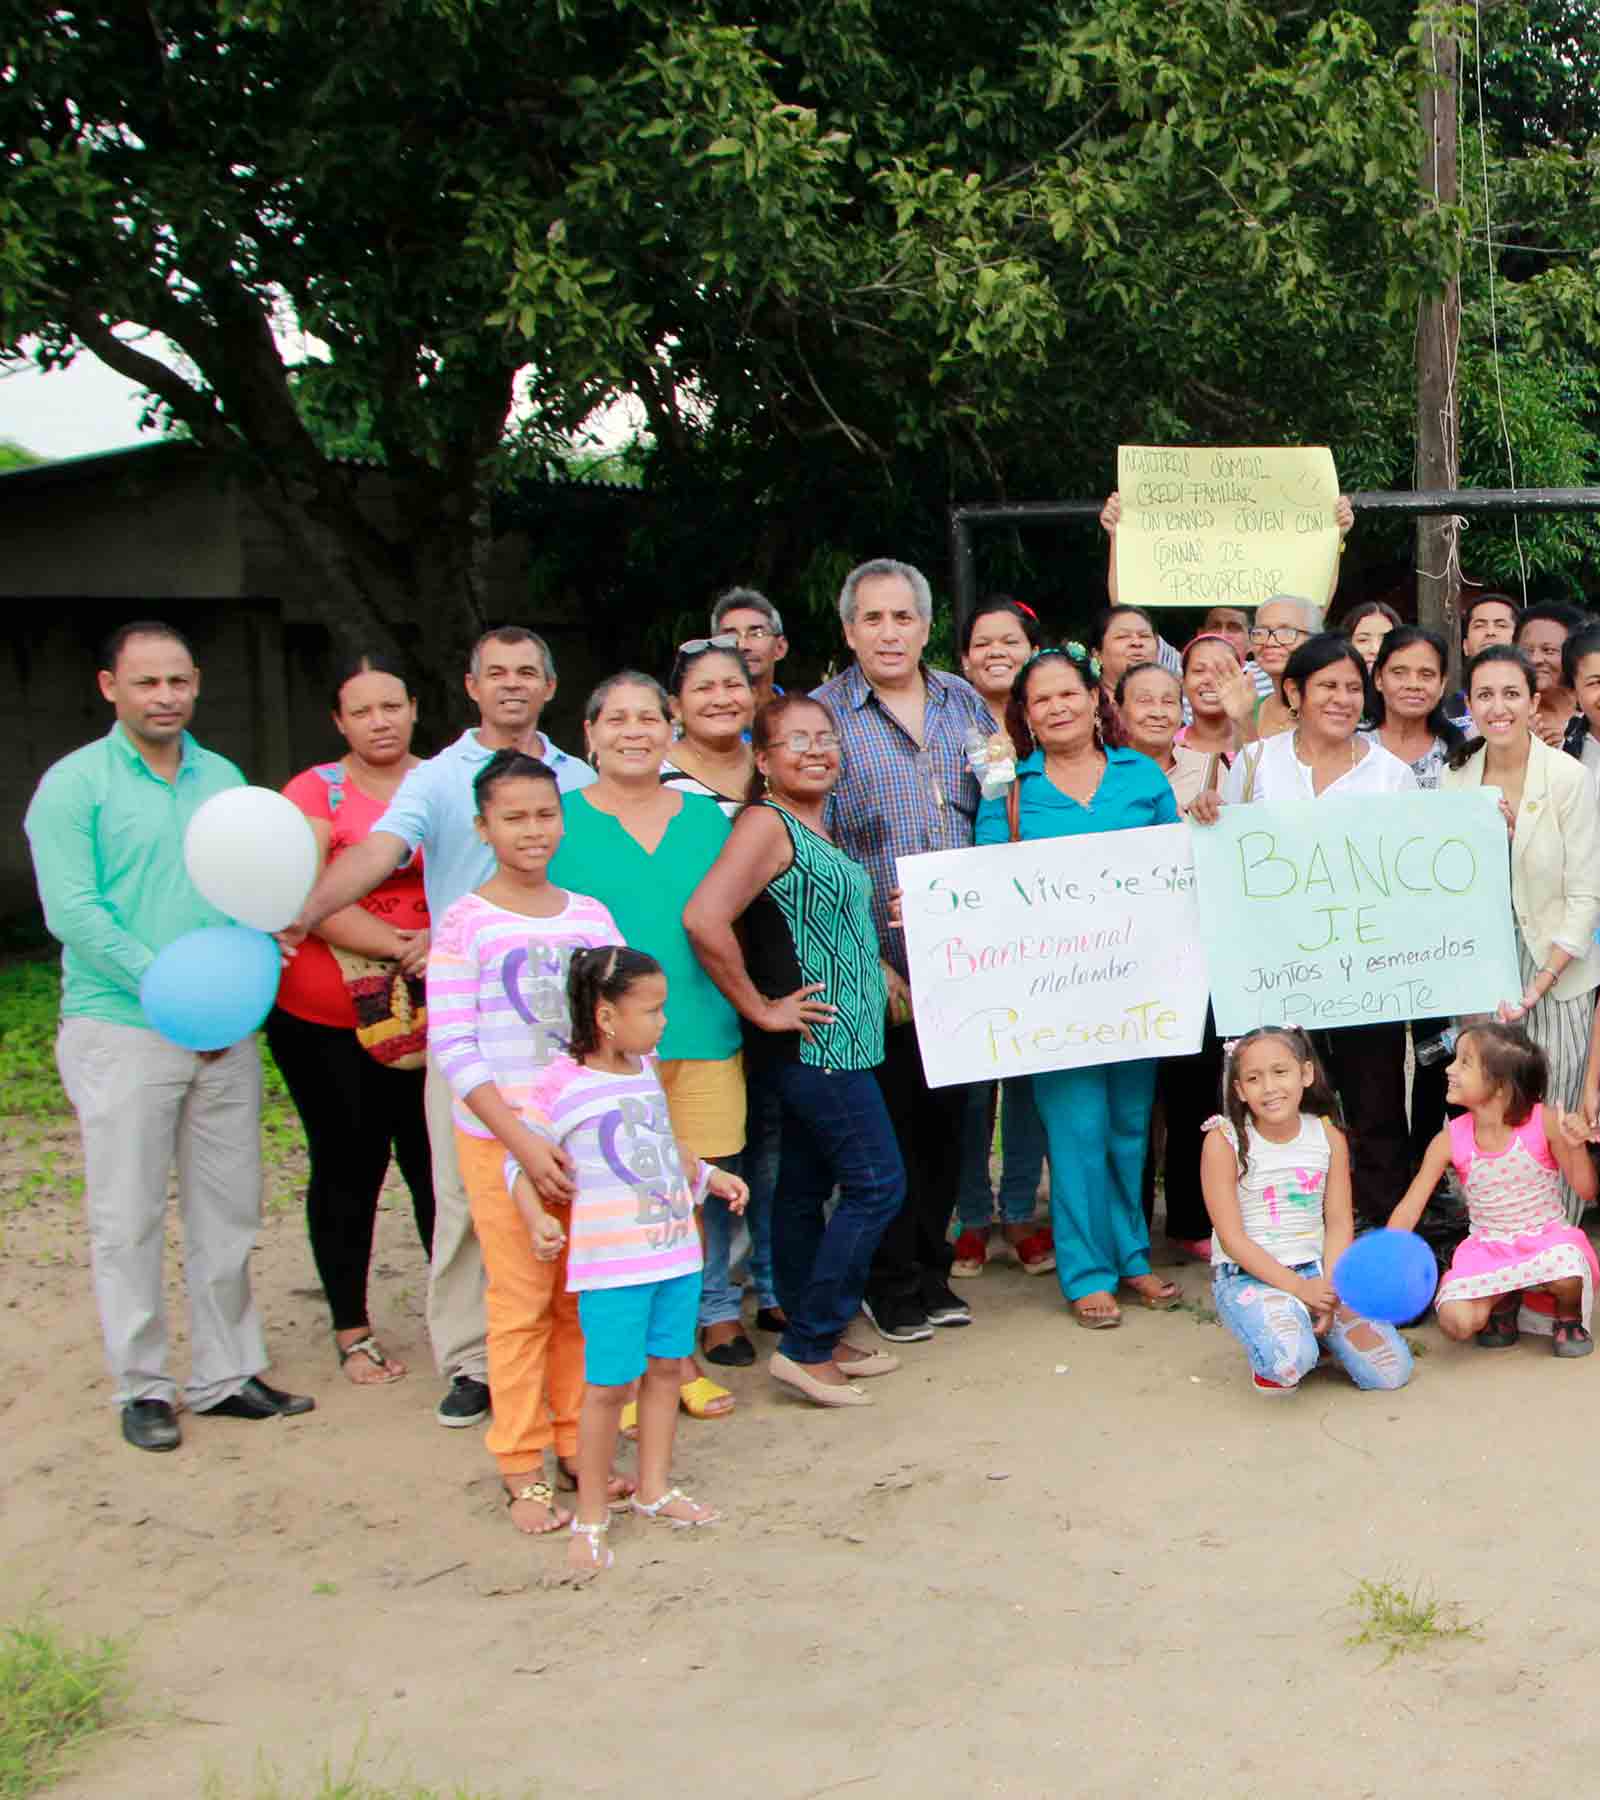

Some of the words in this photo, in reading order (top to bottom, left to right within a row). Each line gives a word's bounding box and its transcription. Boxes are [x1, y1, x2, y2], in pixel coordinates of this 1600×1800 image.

[924, 878, 984, 914] Se
[1100, 866, 1145, 896] Se
[1237, 831, 1477, 898] BANCO
